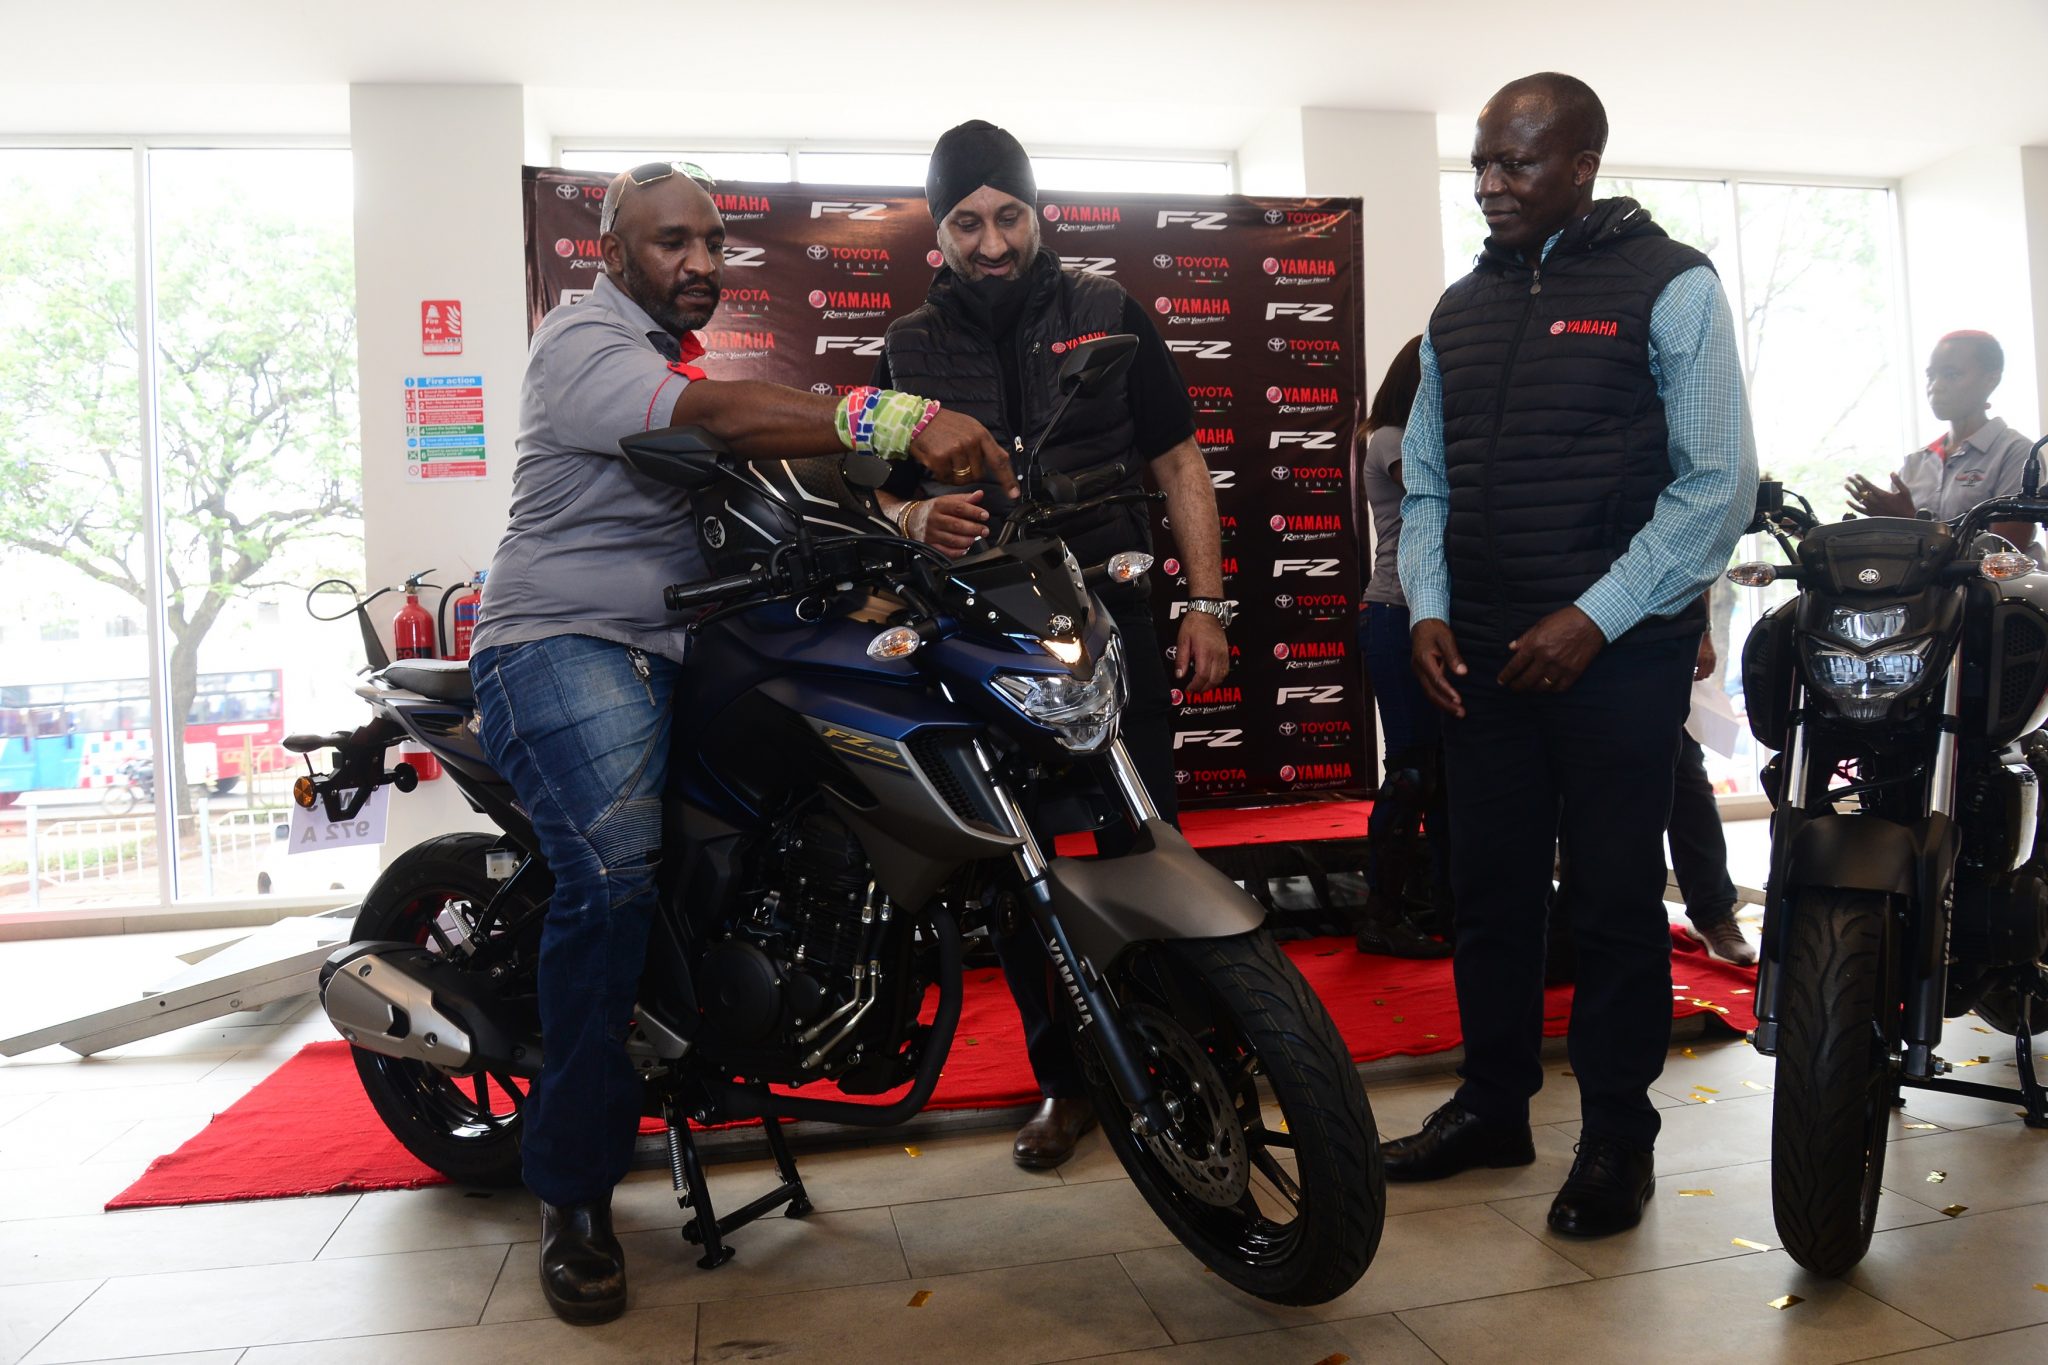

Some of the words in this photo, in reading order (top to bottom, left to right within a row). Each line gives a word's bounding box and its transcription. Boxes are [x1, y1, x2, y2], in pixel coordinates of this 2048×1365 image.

[810, 201, 888, 220] FZ
[1061, 206, 1121, 222] YAMAHA
[1286, 212, 1337, 224] TOYOTA
[1157, 210, 1228, 230] FZ
[832, 247, 889, 260] TOYOTA
[834, 262, 889, 270] KENYA
[1176, 256, 1230, 268] TOYOTA
[1280, 259, 1336, 275] YAMAHA
[720, 288, 770, 301] OYOTA
[827, 291, 892, 309] YAMAHA
[1172, 298, 1231, 314] YAMAHA
[1265, 302, 1334, 322] FZ
[1566, 320, 1618, 336] YAMAHA
[708, 331, 775, 349] YAMAHA
[1289, 340, 1340, 351] TOYOTA
[446, 377, 476, 385] action
[1187, 386, 1233, 398] OYOTA
[1284, 388, 1339, 403] YAMAHA
[1269, 431, 1337, 449] FZ
[1292, 467, 1343, 479] TOYOTA
[1286, 515, 1342, 530] YAMAHA
[1272, 558, 1340, 578] FZ
[1296, 595, 1347, 606] TOYOTA
[1290, 642, 1346, 658] YAMAHA
[1277, 685, 1345, 706] FZ
[1300, 721, 1350, 733] TOYOTA
[1172, 728, 1243, 749] FZ
[1193, 769, 1247, 781] TOYOTA
[1296, 763, 1352, 780] YAMAHA
[1048, 937, 1094, 1027] YAMAHA
